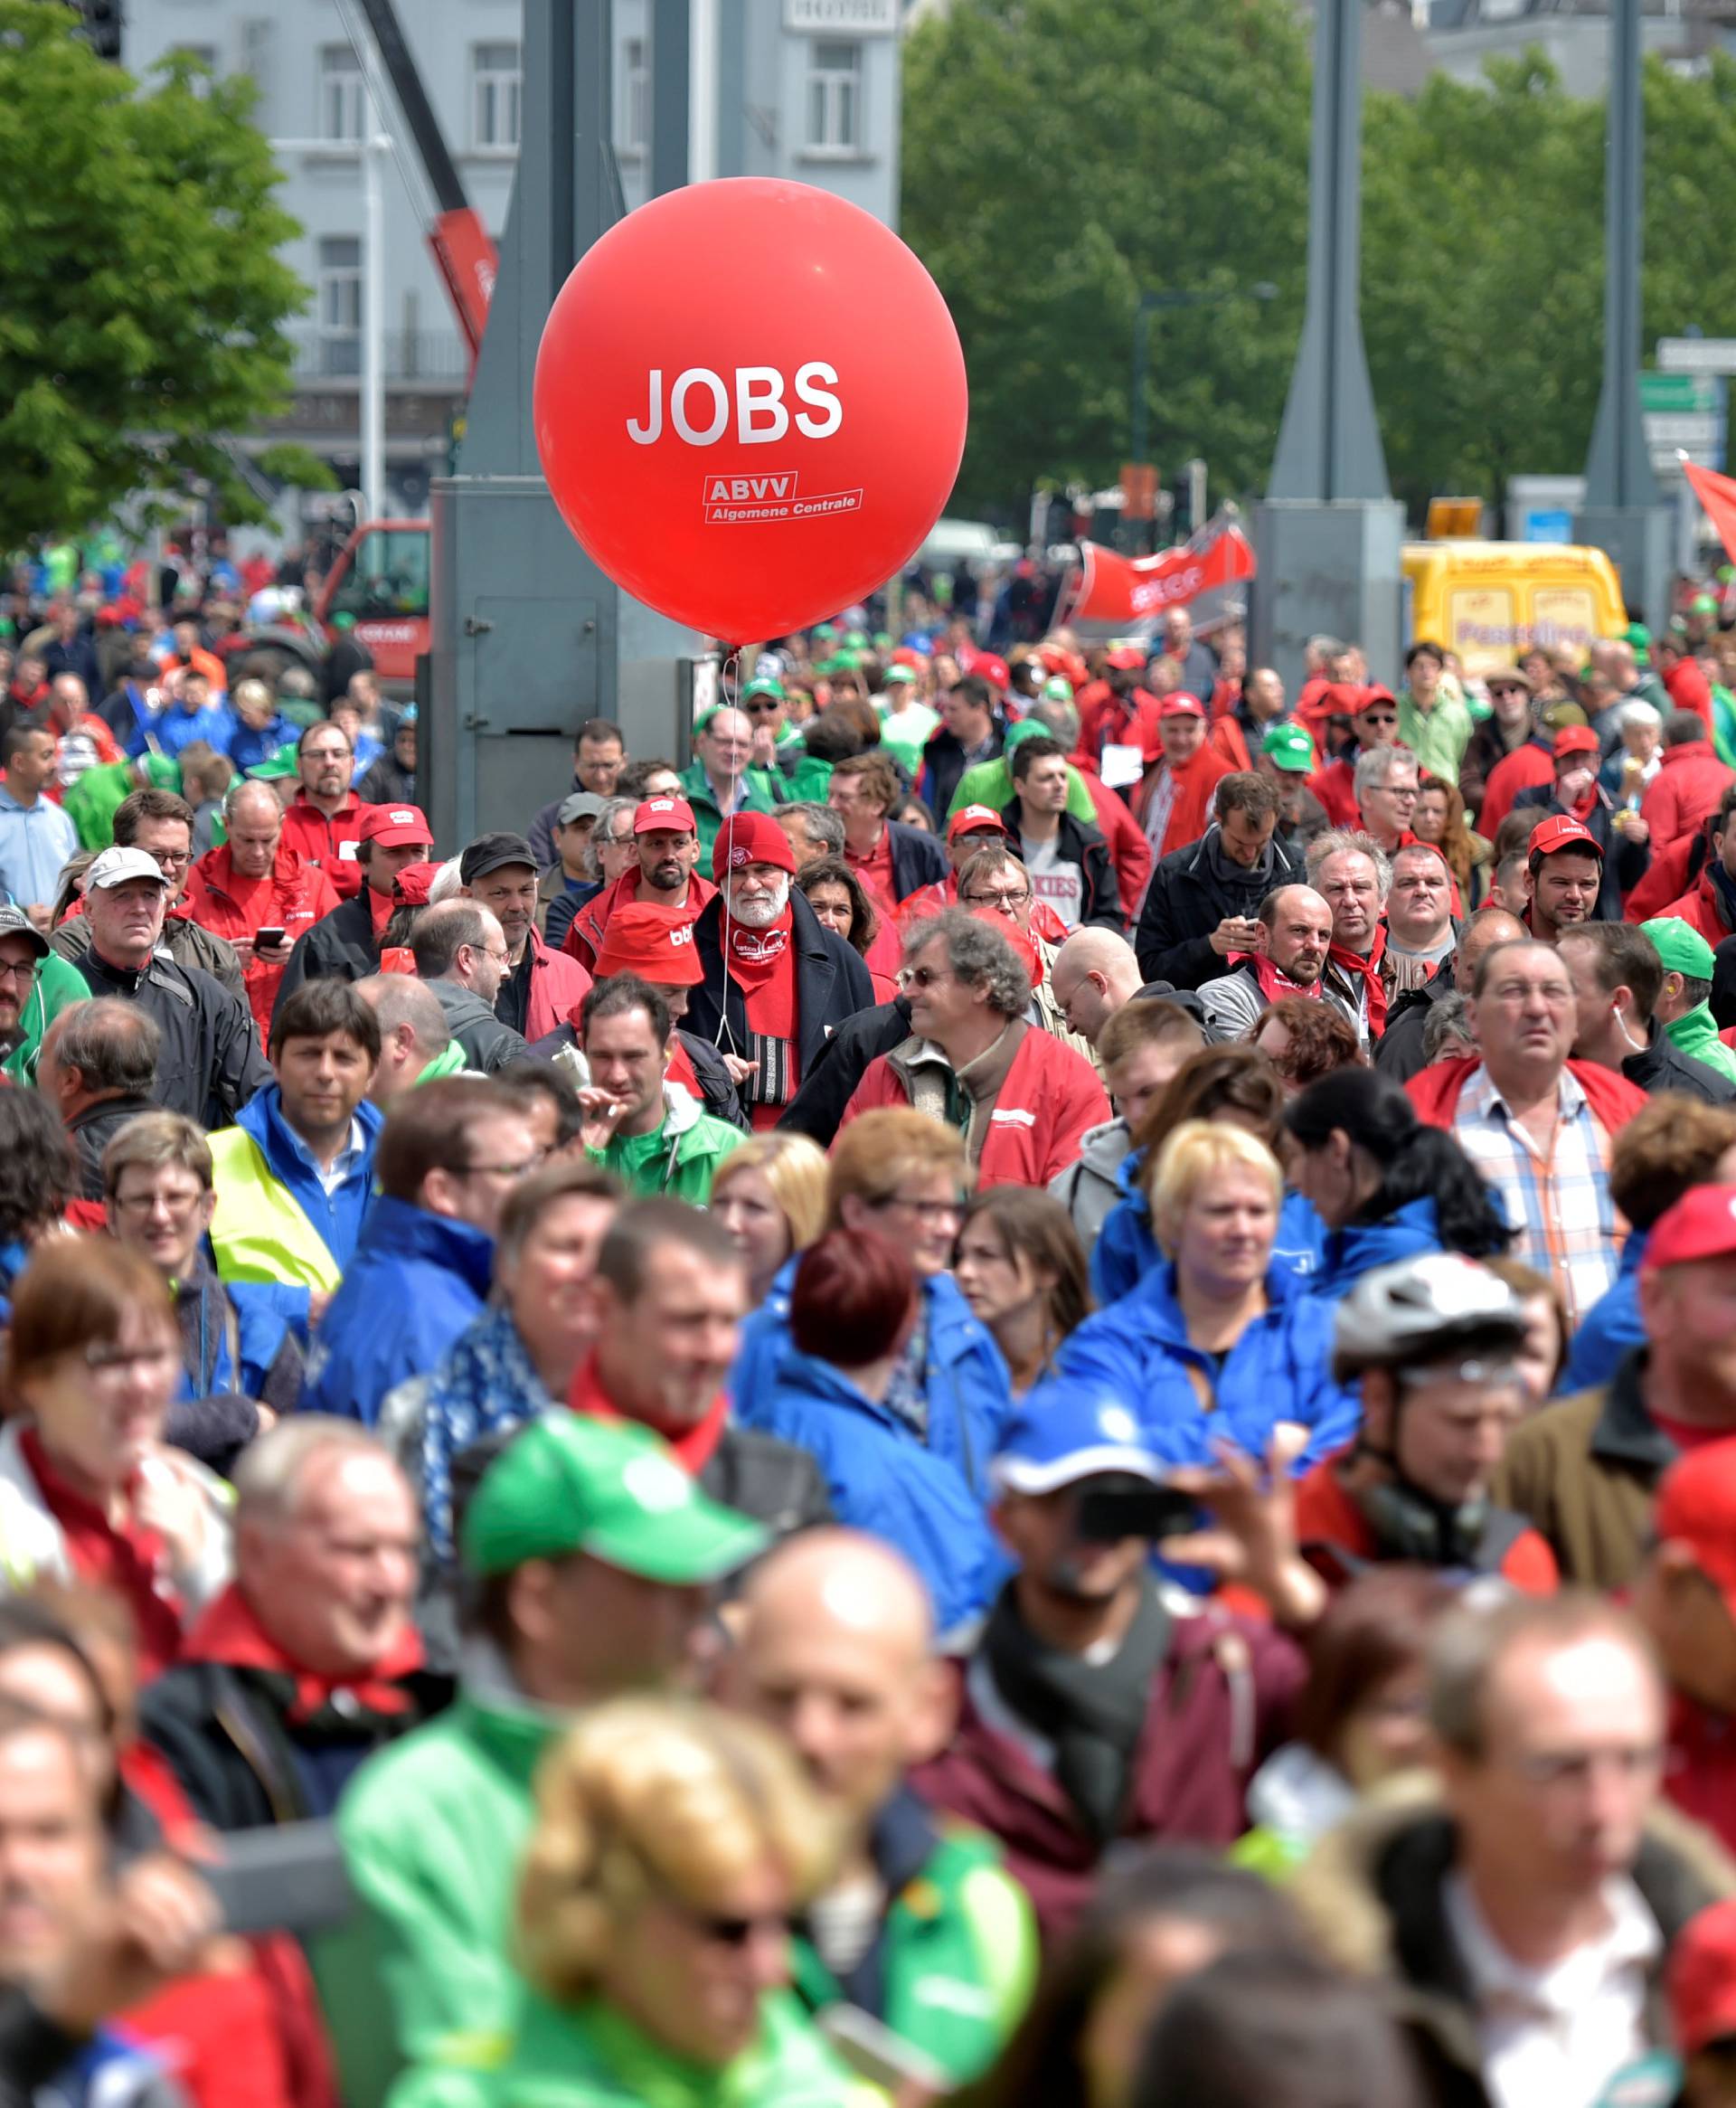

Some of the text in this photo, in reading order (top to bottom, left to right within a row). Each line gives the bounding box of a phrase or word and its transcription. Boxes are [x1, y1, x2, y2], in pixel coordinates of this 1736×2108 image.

[626, 361, 843, 447] JOBS
[710, 477, 789, 501] ABVV
[712, 496, 855, 521] Algemene Centrale
